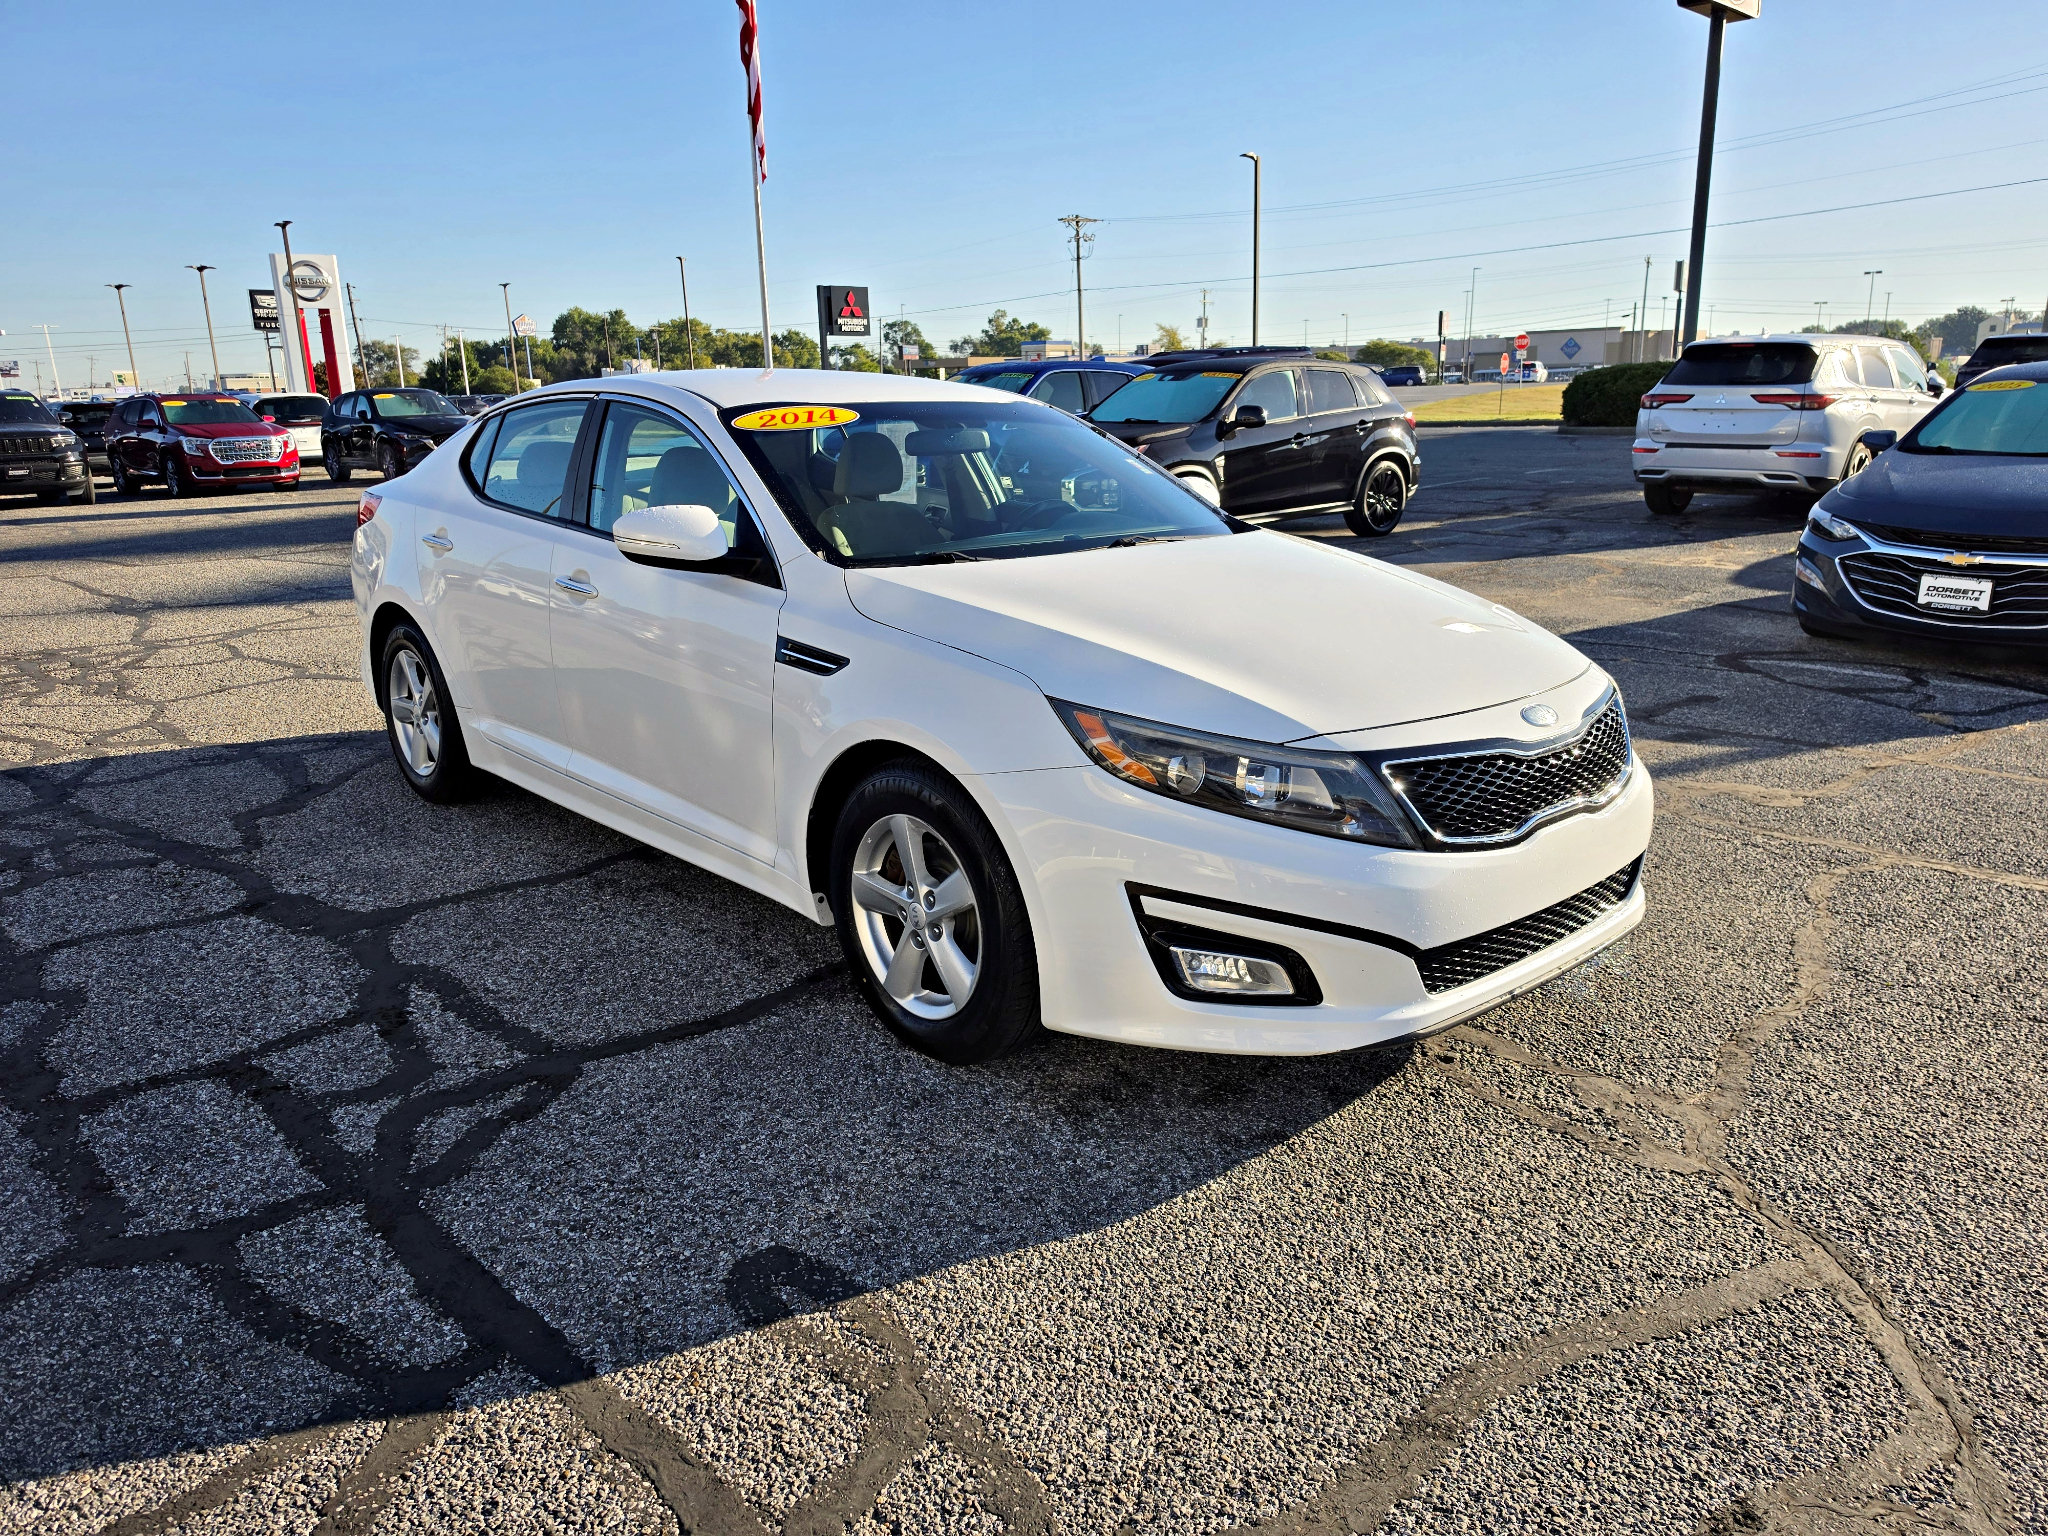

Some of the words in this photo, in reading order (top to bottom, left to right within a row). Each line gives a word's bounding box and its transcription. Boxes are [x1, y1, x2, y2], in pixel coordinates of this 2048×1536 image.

[1515, 338, 1529, 346] STOP
[758, 409, 839, 428] 2014
[1926, 585, 1987, 597] DORSETT
[1923, 592, 1981, 602] AUTOMOTIVE
[1930, 602, 1973, 612] DORSETT
